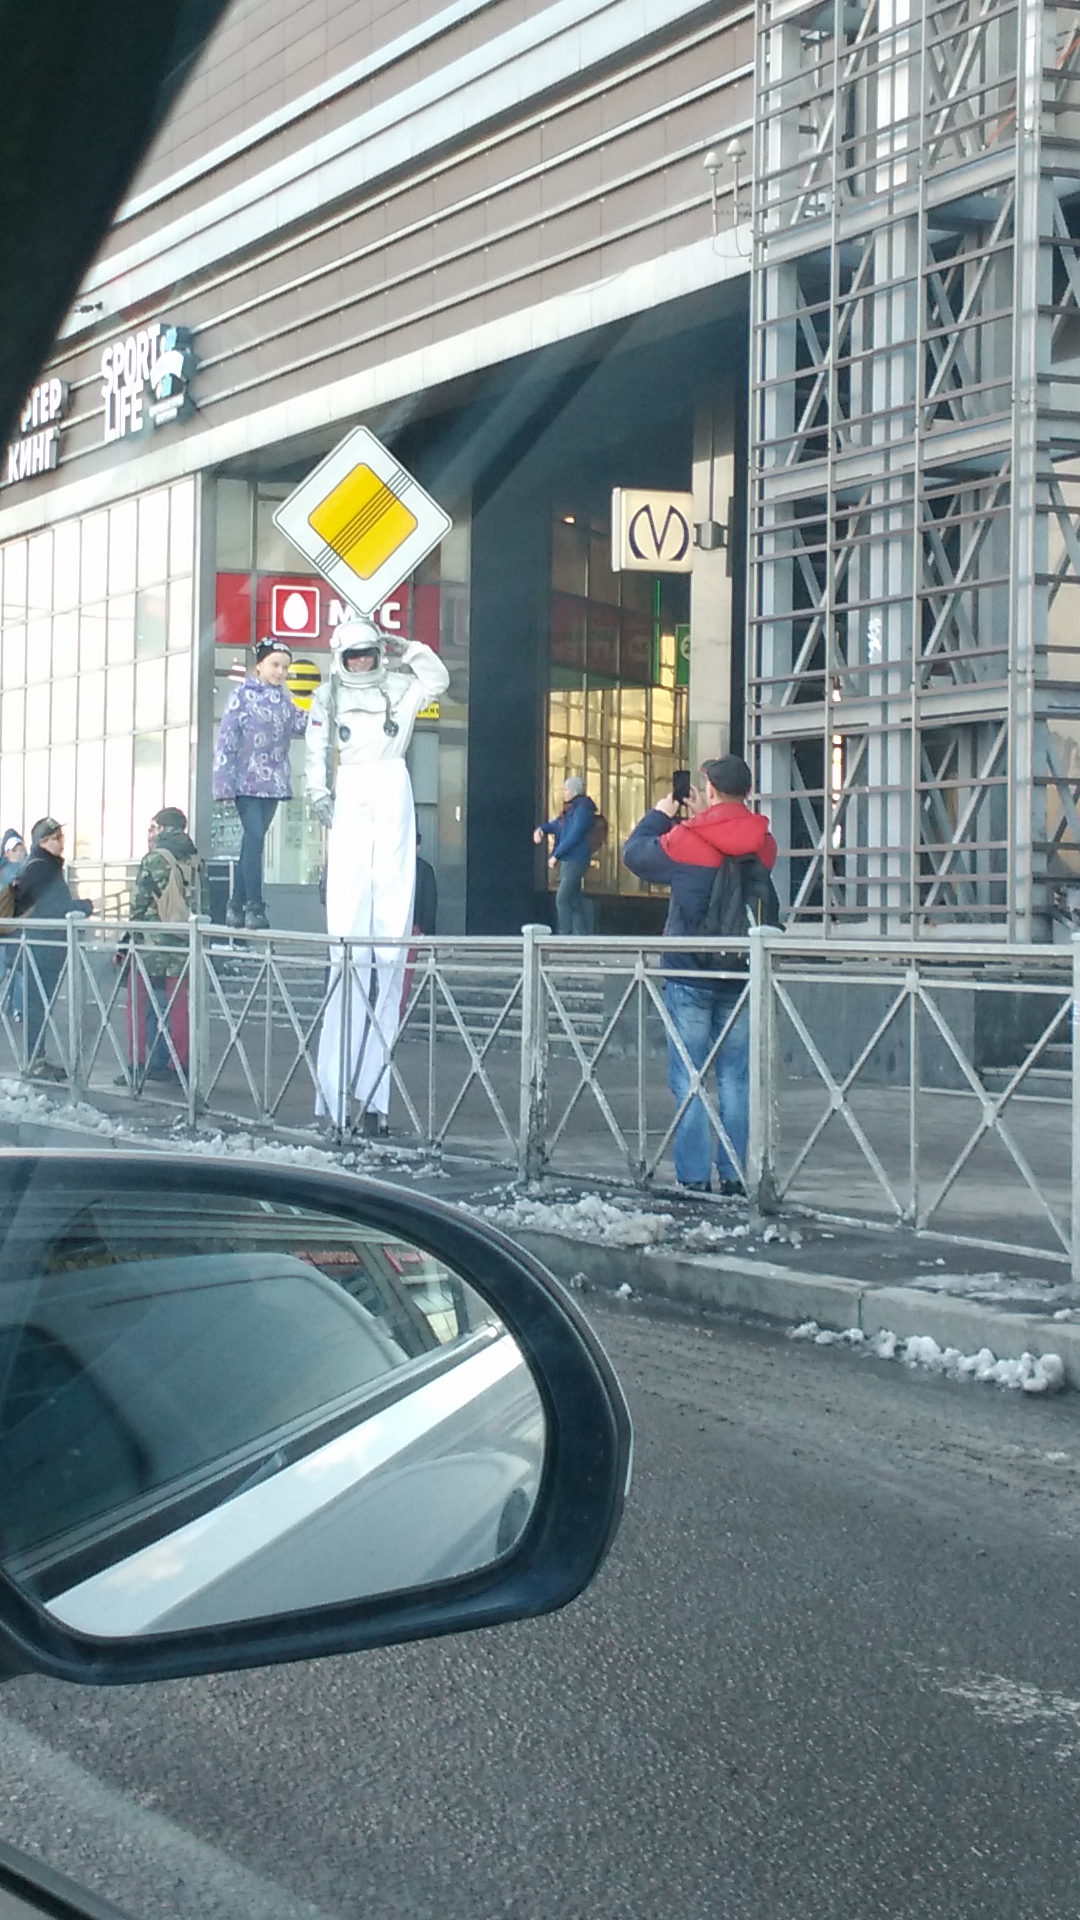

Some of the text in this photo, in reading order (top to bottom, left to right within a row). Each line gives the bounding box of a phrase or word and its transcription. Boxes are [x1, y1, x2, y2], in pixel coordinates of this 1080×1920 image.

[101, 323, 160, 400] SPORT
[104, 379, 144, 443] LIFE
[8, 428, 54, 483] КИНГ
